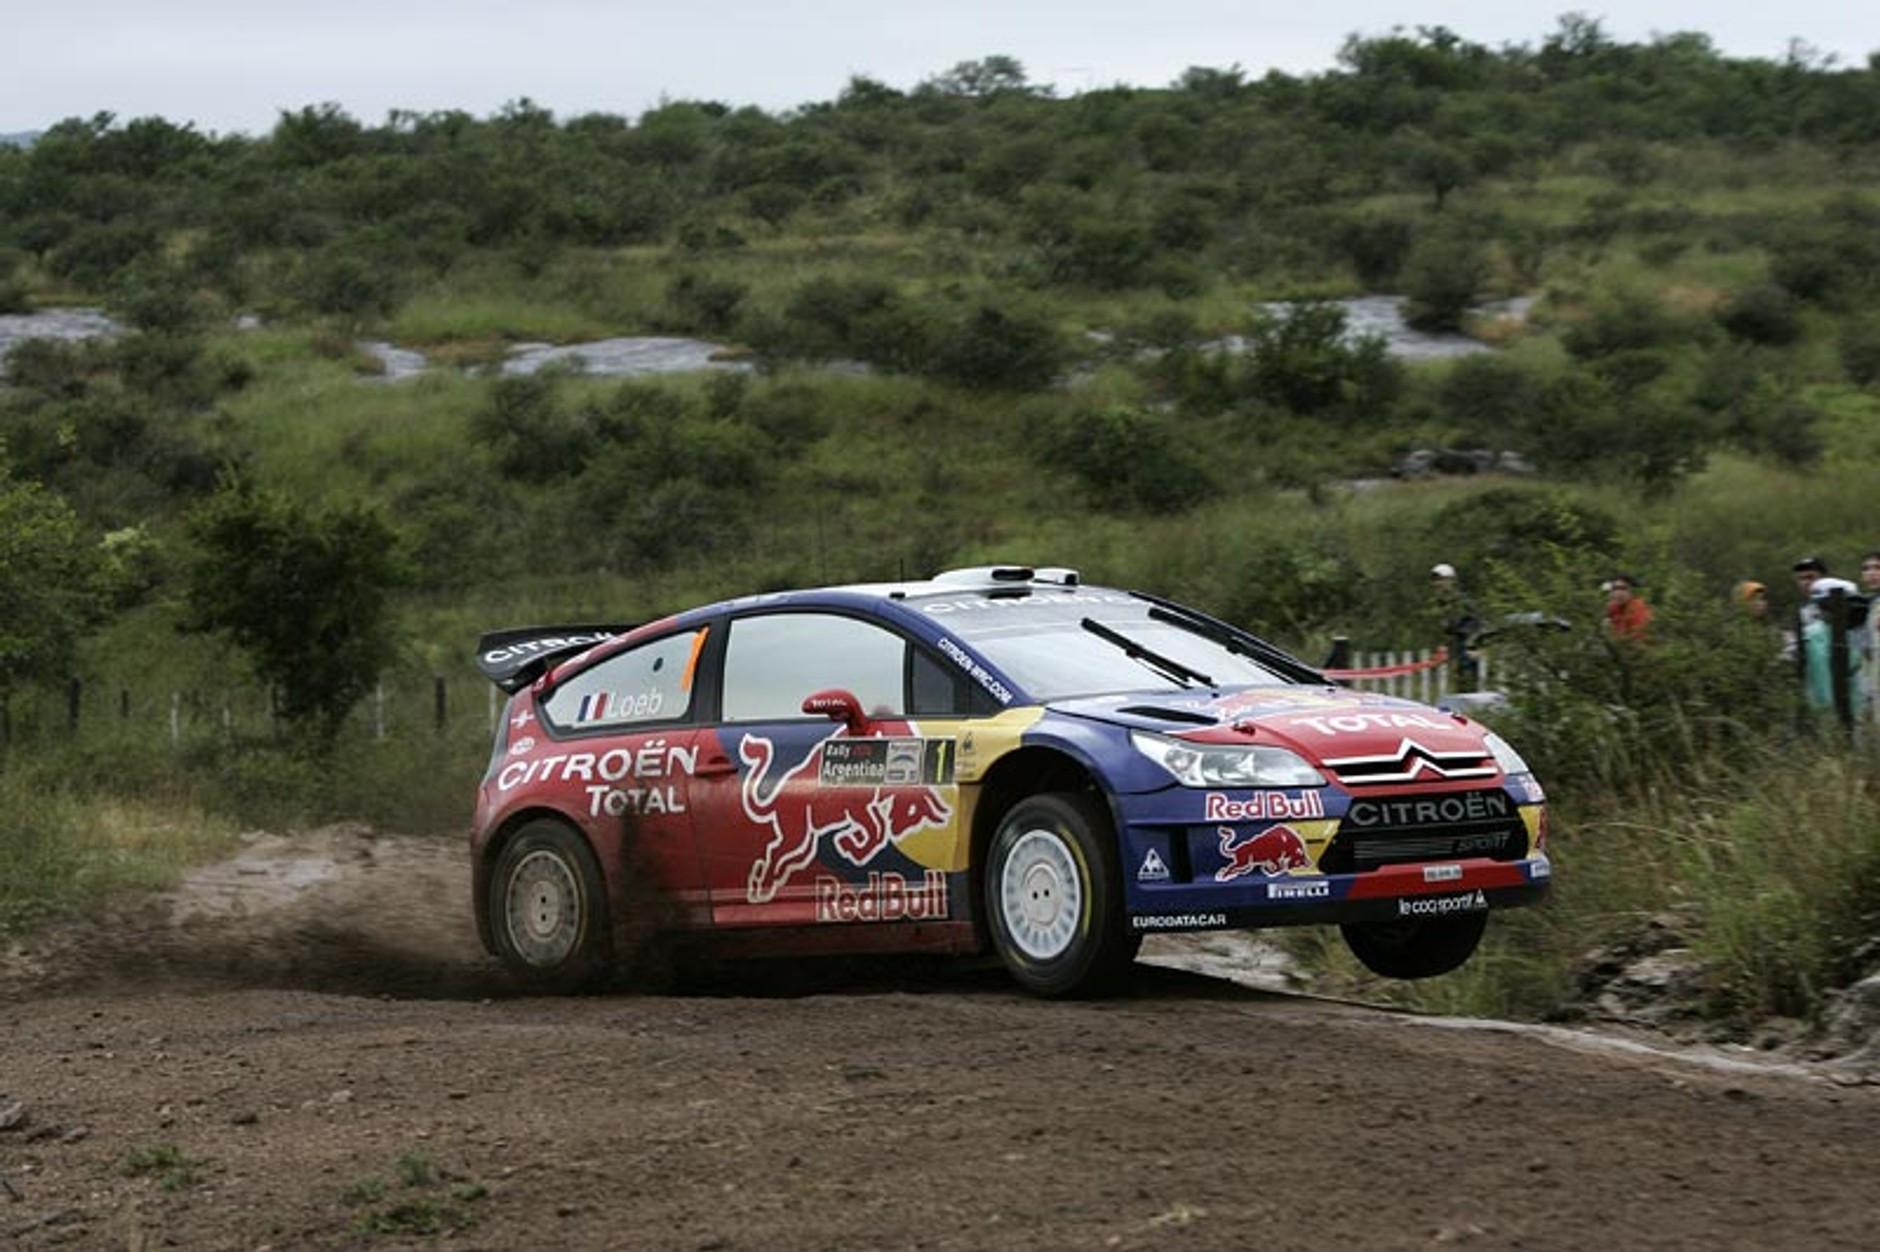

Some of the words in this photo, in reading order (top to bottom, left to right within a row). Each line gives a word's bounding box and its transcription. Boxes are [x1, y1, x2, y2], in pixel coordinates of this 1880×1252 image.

[484, 632, 616, 663] CITRO
[608, 687, 661, 718] Loeb
[1291, 713, 1452, 735] TOTAL
[497, 739, 699, 791] CITROËN
[823, 759, 885, 778] Argentina
[936, 741, 947, 783] 1
[585, 786, 686, 816] TOTAL
[1205, 793, 1264, 821] Red
[1266, 790, 1324, 819] Bull
[1350, 792, 1507, 826] CITROËN
[816, 872, 880, 921] Red
[881, 869, 948, 919] Bull
[1267, 882, 1329, 899] PIRELLI
[1438, 892, 1474, 913] sportif
